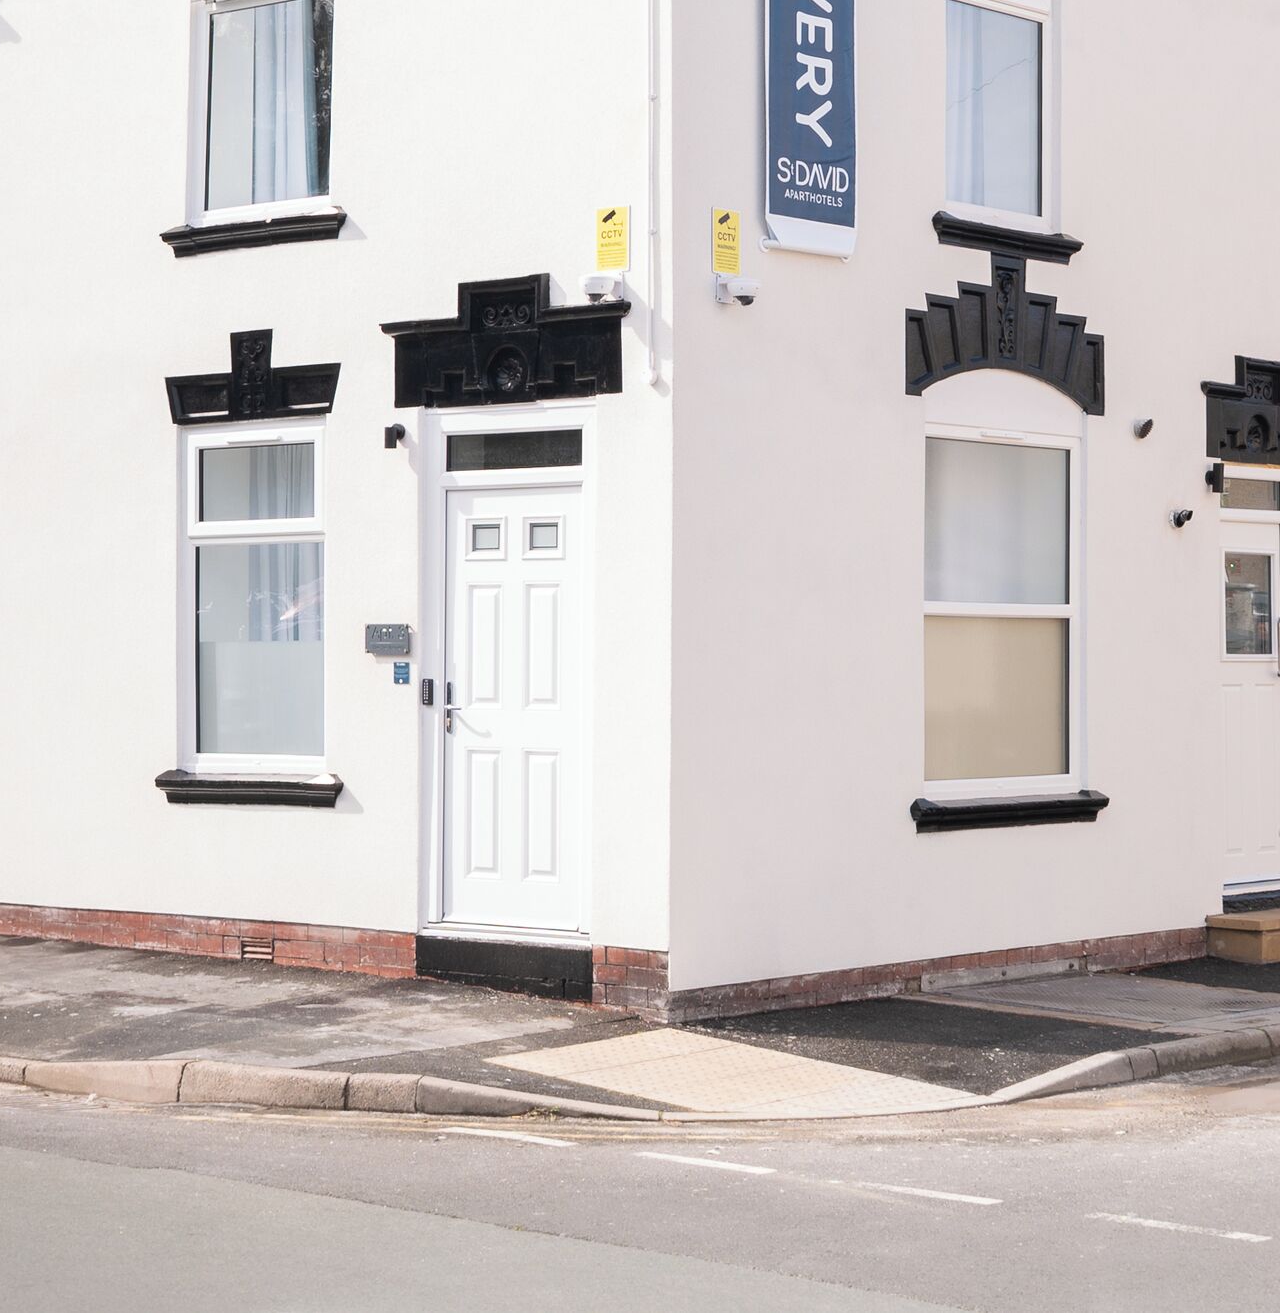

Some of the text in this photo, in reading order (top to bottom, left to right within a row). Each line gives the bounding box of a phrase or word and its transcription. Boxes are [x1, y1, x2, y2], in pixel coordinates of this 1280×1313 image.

[795, 160, 849, 192] DAVID
[784, 188, 843, 207] APARTHOTELS
[601, 229, 623, 239] CCTV
[717, 232, 736, 242] CCTV
